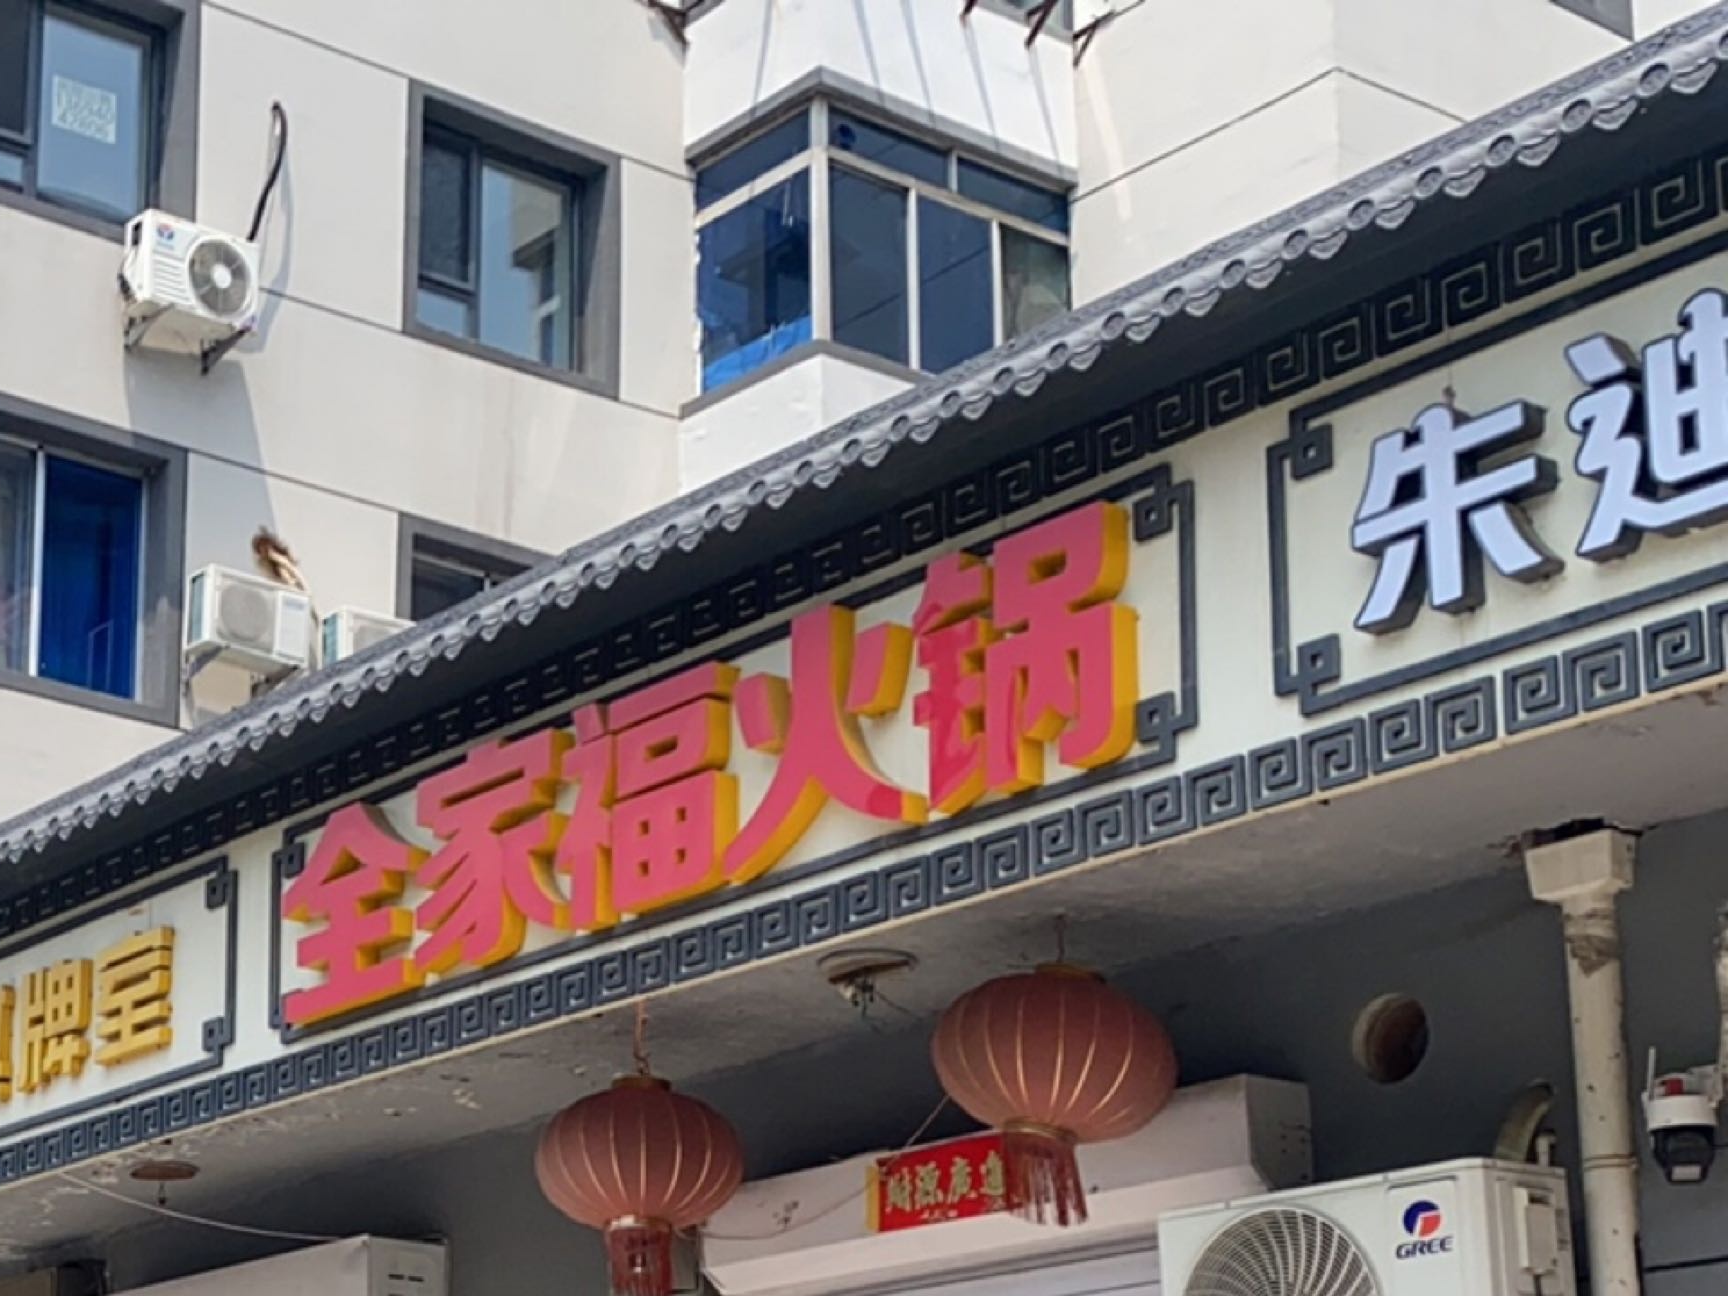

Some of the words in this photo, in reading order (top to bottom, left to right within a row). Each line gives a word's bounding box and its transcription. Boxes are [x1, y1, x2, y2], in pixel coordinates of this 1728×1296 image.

[282, 501, 1139, 1024] 全家福火锅
[1395, 1236, 1453, 1260] GREE
